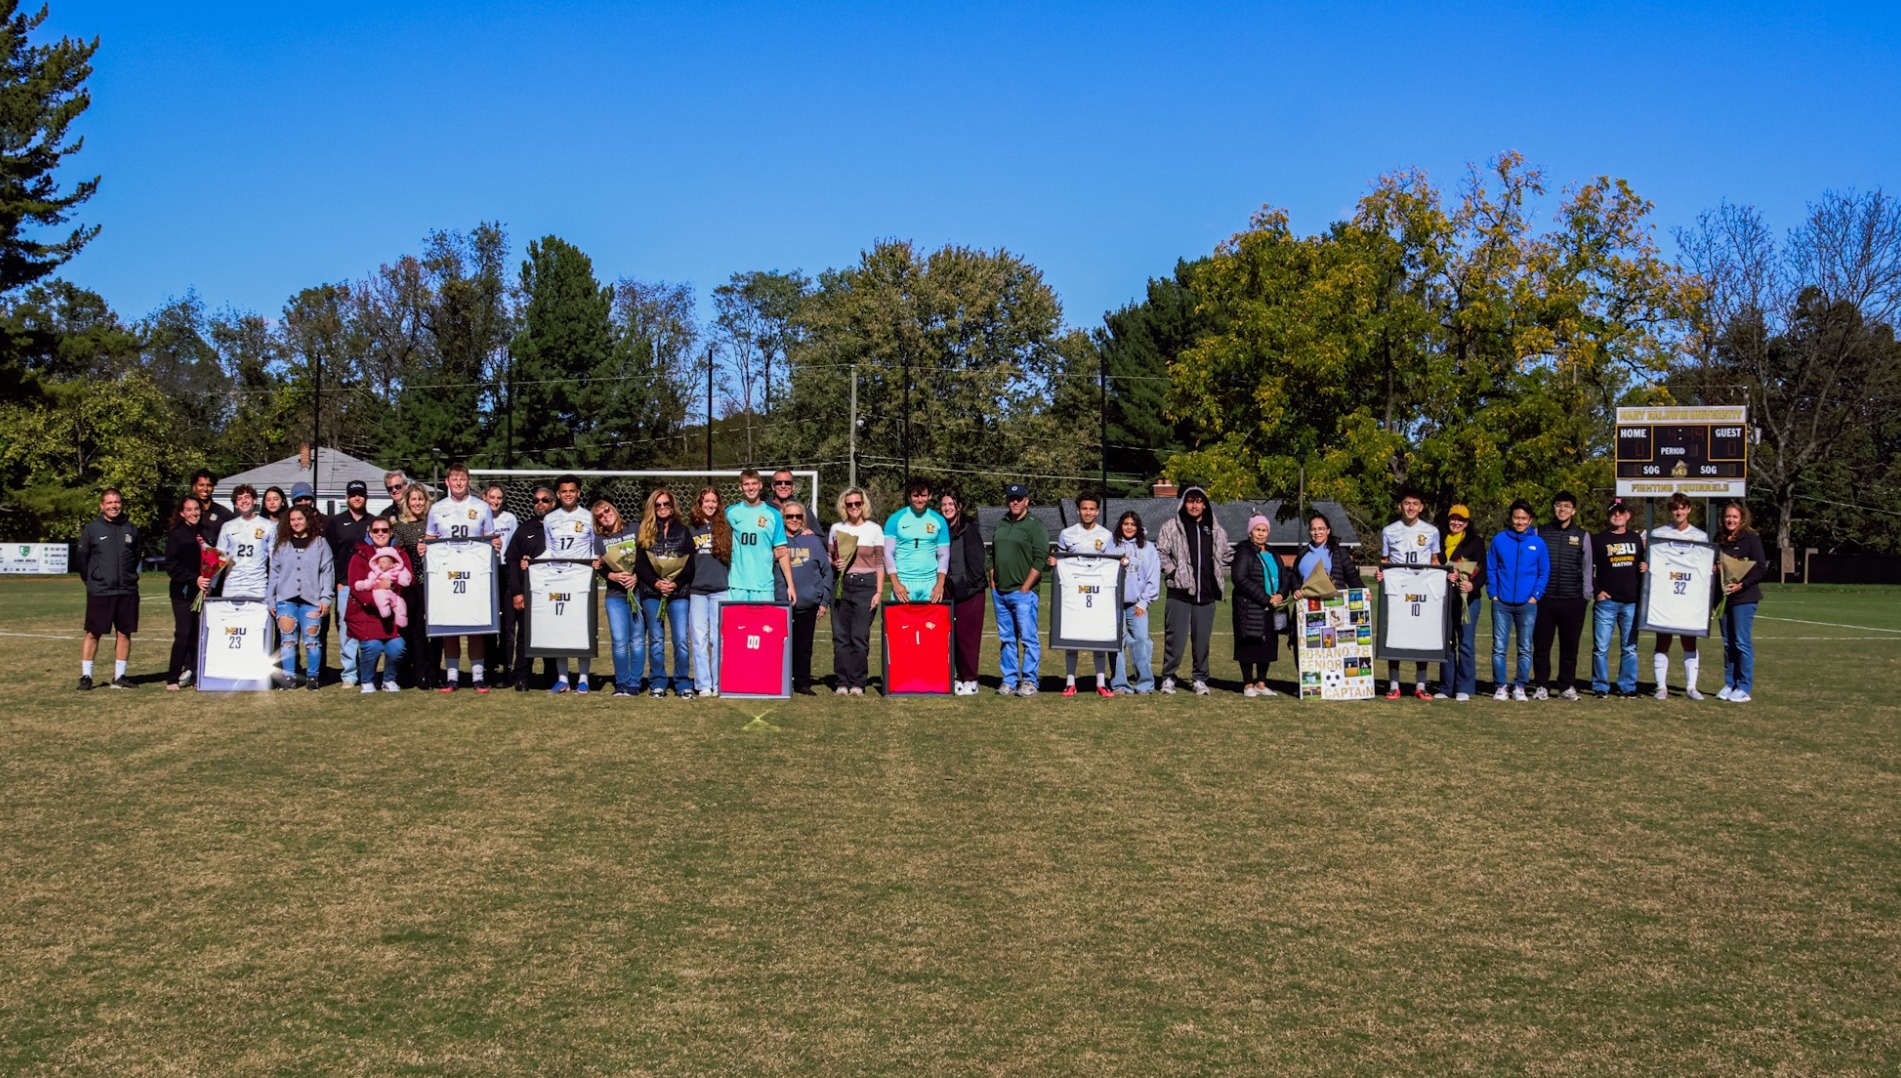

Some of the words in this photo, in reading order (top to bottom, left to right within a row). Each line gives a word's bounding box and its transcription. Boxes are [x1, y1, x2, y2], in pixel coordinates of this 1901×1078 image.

[1620, 428, 1647, 438] HOME
[1715, 428, 1742, 438] GUEST
[1660, 447, 1686, 455] PERIOD
[1643, 465, 1660, 475] SOG
[1700, 465, 1717, 475] SOG
[1631, 483, 1673, 493] FIGHTING
[1677, 483, 1730, 493] SQUIRRELS
[451, 525, 469, 538] 20
[560, 537, 575, 550] 17
[741, 532, 757, 546] 00
[914, 537, 919, 549] 1
[237, 544, 254, 557] 23
[1606, 542, 1637, 556] MBU
[1405, 551, 1418, 564] 10
[447, 571, 471, 580] MBU
[1669, 571, 1692, 581] MBU
[453, 580, 466, 594] 20
[1078, 585, 1100, 594] MBU
[1673, 581, 1687, 596] 32
[548, 592, 571, 602] MBU
[1086, 594, 1093, 608] 8
[1404, 594, 1427, 603] MBU
[555, 602, 565, 616] 17
[1411, 603, 1421, 617] 10
[1298, 599, 1306, 647] AVID
[225, 626, 247, 636] MBU
[229, 636, 242, 649] 23
[747, 634, 760, 650] 00
[915, 630, 921, 646] 1
[1300, 660, 1343, 671] SENIOR
